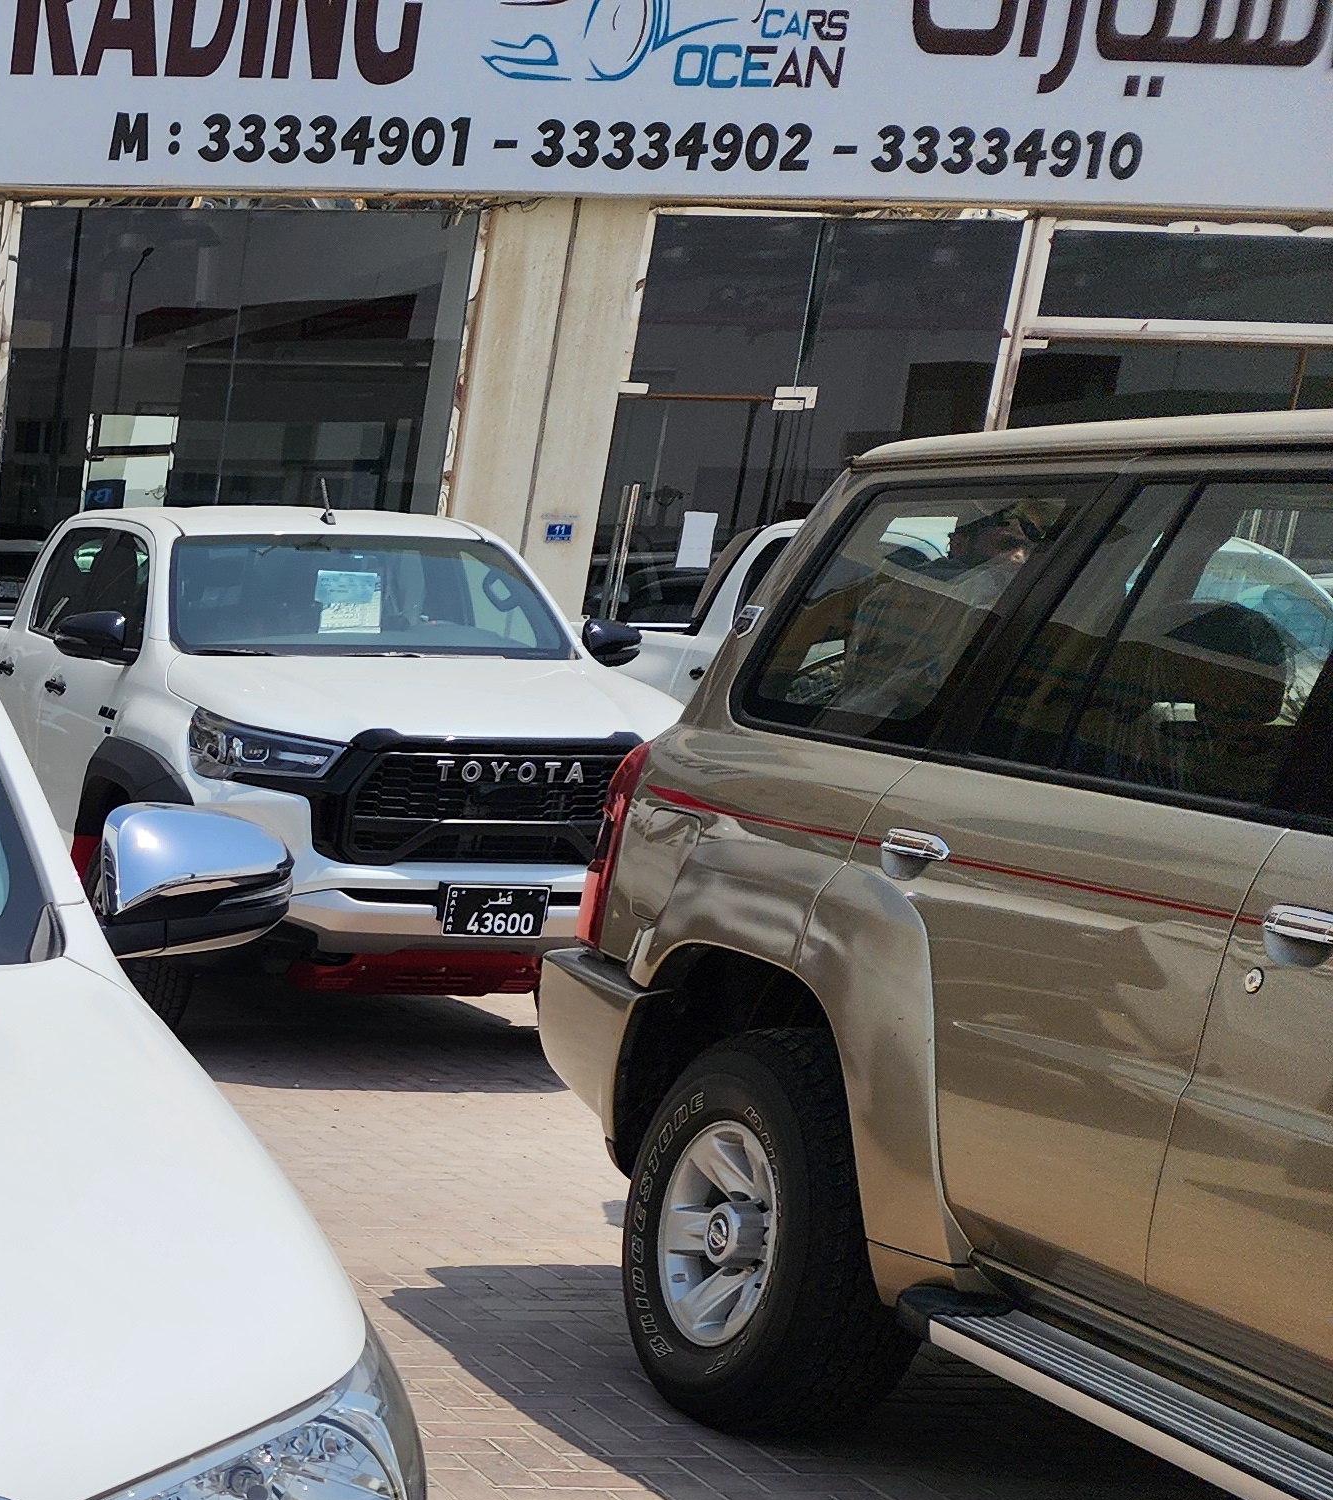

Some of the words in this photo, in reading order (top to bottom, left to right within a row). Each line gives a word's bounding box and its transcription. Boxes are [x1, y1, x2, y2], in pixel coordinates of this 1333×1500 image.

[761, 9, 850, 41] CARS
[673, 44, 848, 89] OCEAN
[197, 114, 473, 167] 33334901
[531, 119, 814, 172] 33334902
[870, 124, 1144, 181] 33334910
[555, 525, 566, 535] 11
[436, 760, 584, 784] TOYOTA
[445, 890, 458, 932] QATAR
[481, 891, 513, 909] قطر
[466, 911, 534, 934] 43600
